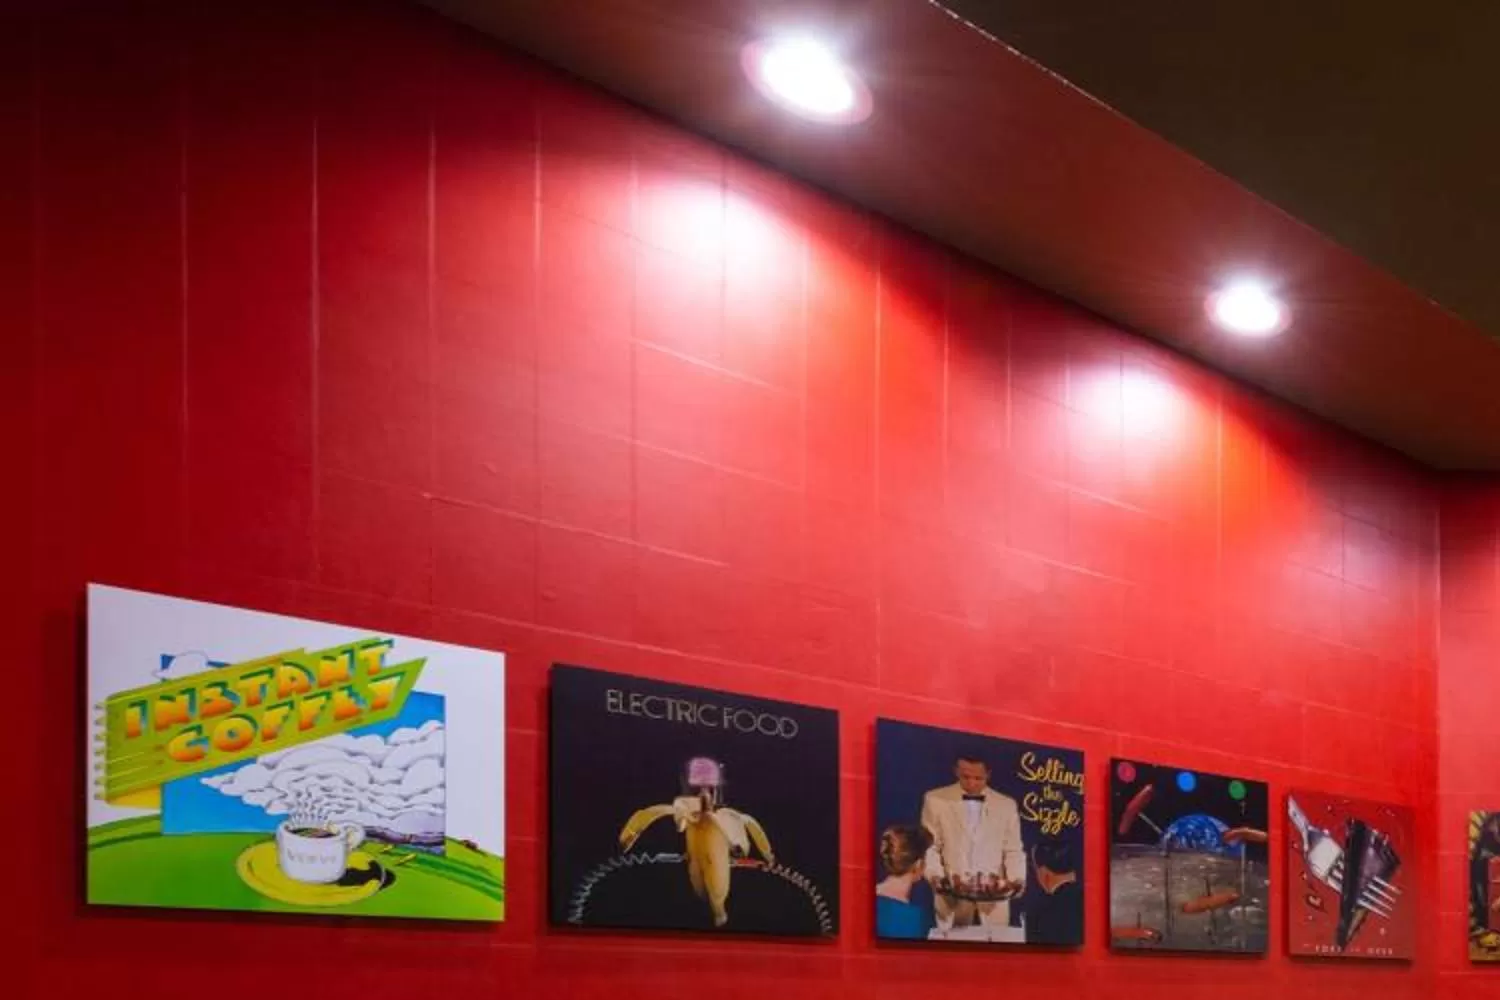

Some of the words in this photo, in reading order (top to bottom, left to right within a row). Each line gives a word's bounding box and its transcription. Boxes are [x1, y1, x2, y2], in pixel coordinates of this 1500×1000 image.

[126, 639, 394, 739] INSTANT
[606, 689, 718, 728] ELECTRIC
[723, 706, 799, 740] FOOD
[1017, 751, 1084, 795] Selling
[1043, 784, 1064, 801] the
[1020, 791, 1081, 835] Sizzle
